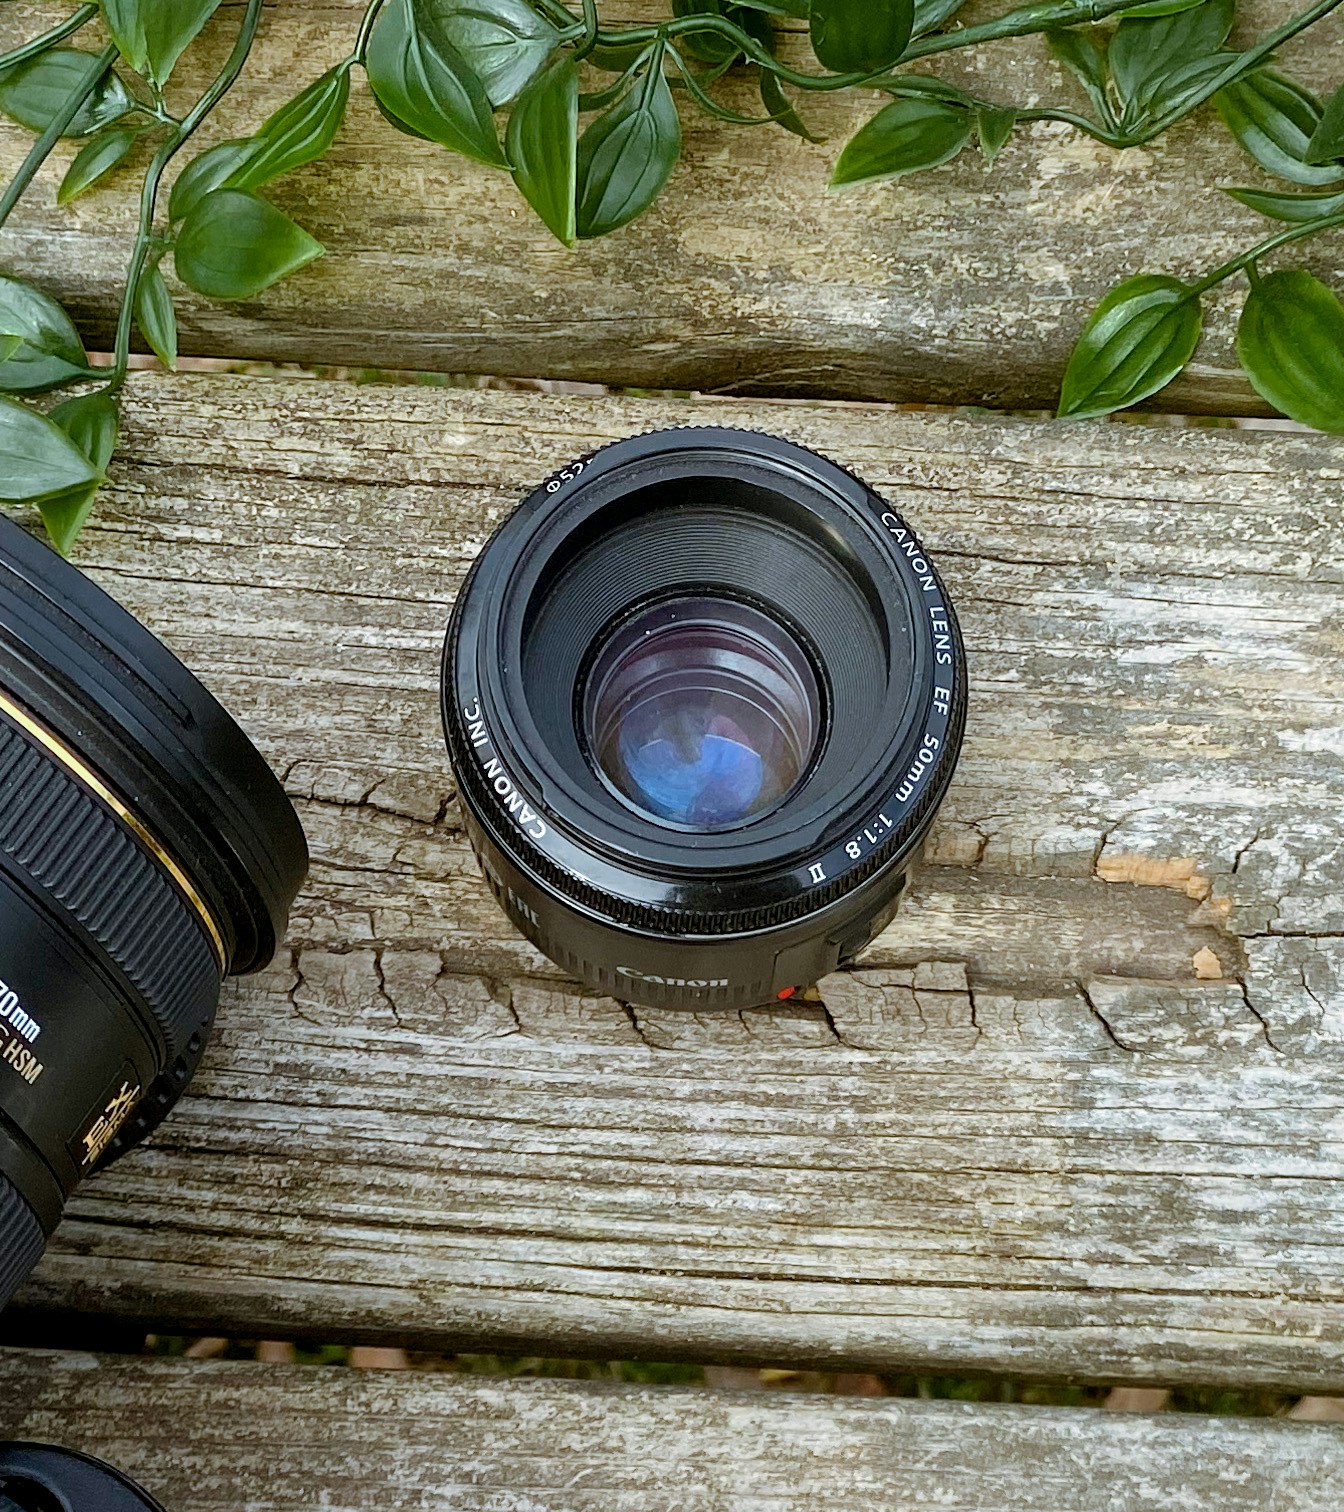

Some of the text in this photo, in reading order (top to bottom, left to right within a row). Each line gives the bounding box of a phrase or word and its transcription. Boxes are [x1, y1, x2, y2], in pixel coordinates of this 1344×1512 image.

[881, 512, 937, 592] CANON
[929, 606, 952, 665] LENS
[464, 696, 489, 748] INC.
[933, 686, 950, 716] EF
[895, 732, 940, 802] 50mm
[483, 758, 547, 839] CANON
[845, 813, 893, 860] 1:1.8
[616, 965, 729, 988] Canon
[2, 1038, 45, 1085] HSM
